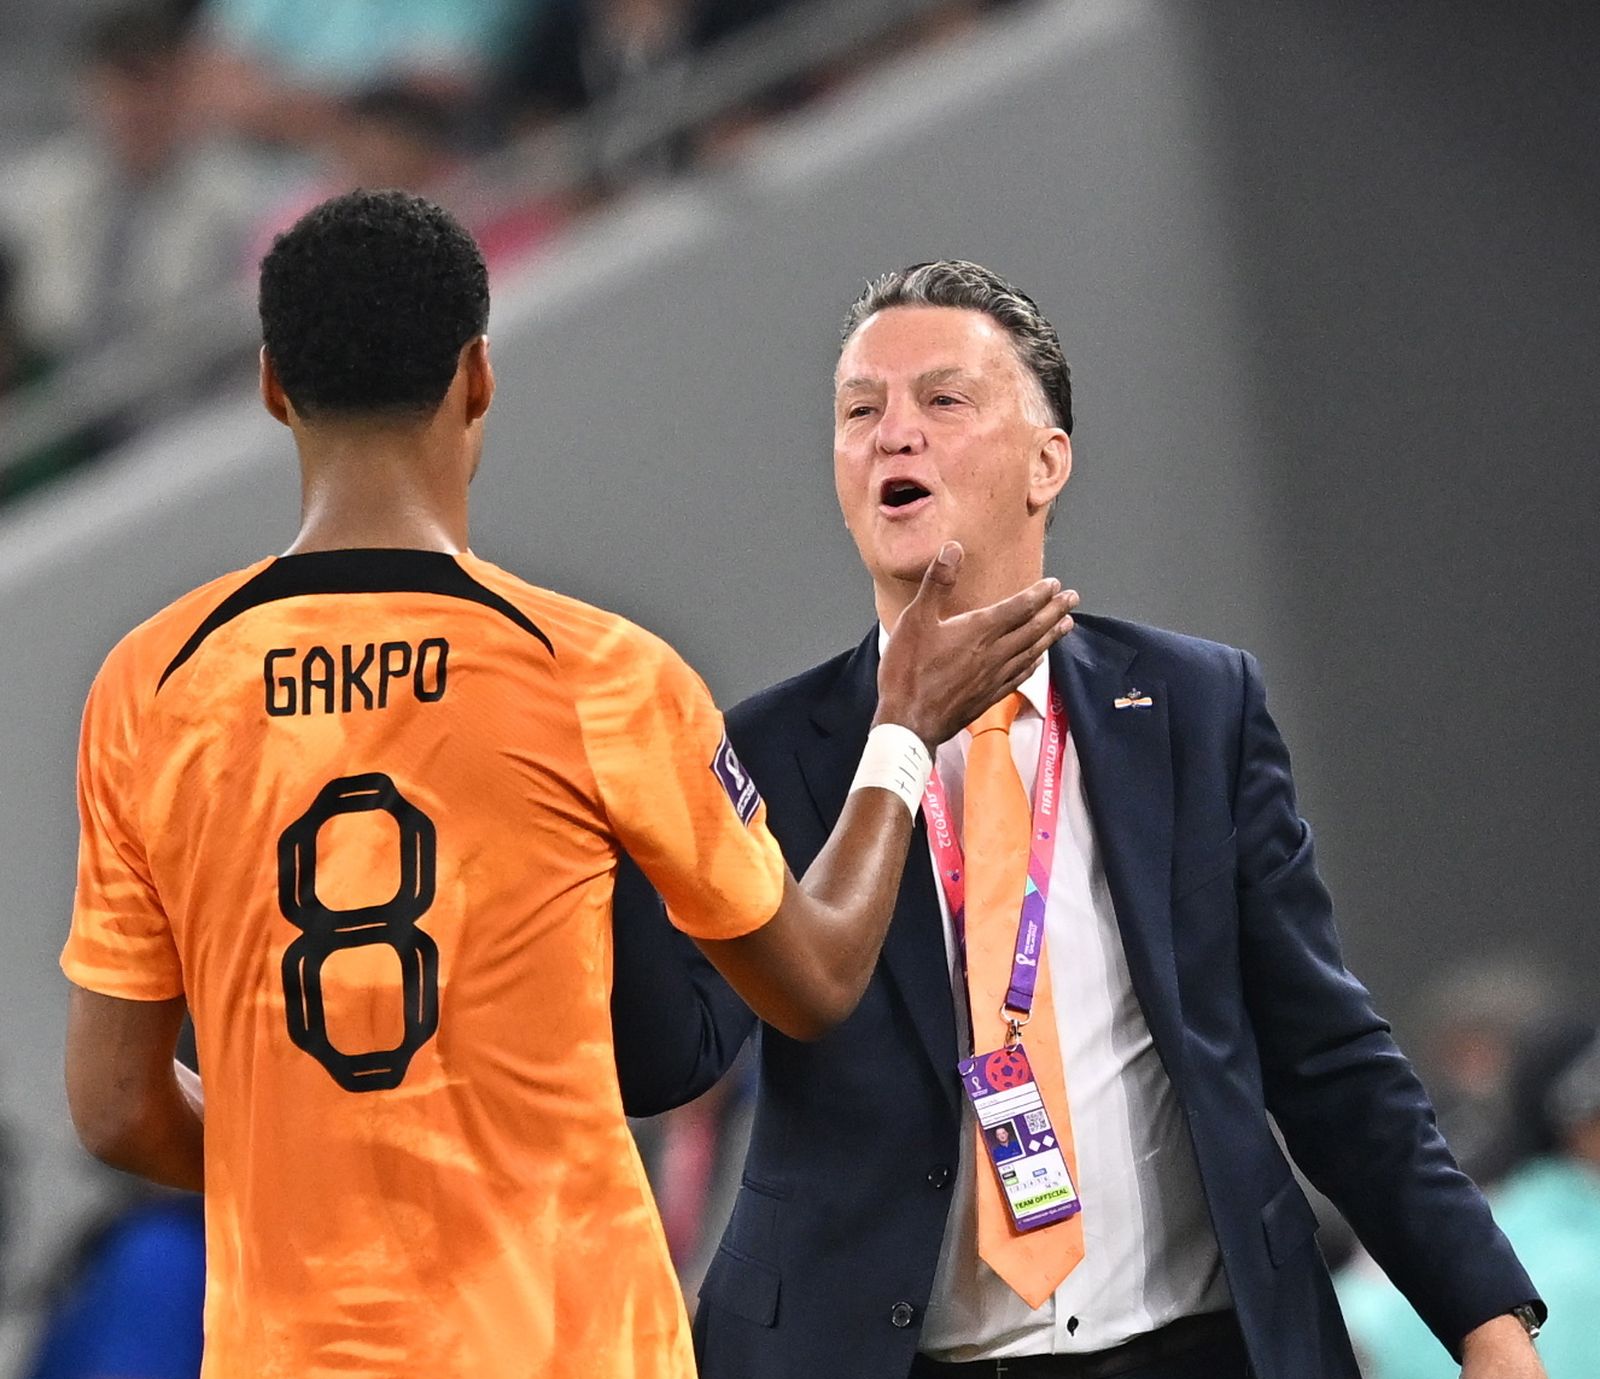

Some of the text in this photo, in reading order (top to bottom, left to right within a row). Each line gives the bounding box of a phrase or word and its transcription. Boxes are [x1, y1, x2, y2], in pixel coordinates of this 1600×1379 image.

[264, 637, 449, 717] GAKPO
[1050, 719, 1060, 744] CUP
[1044, 745, 1056, 789] WORLD
[1041, 790, 1052, 815] FIFA
[277, 772, 439, 1093] 8
[1015, 1188, 1068, 1210] TEAM OFFICIAL
